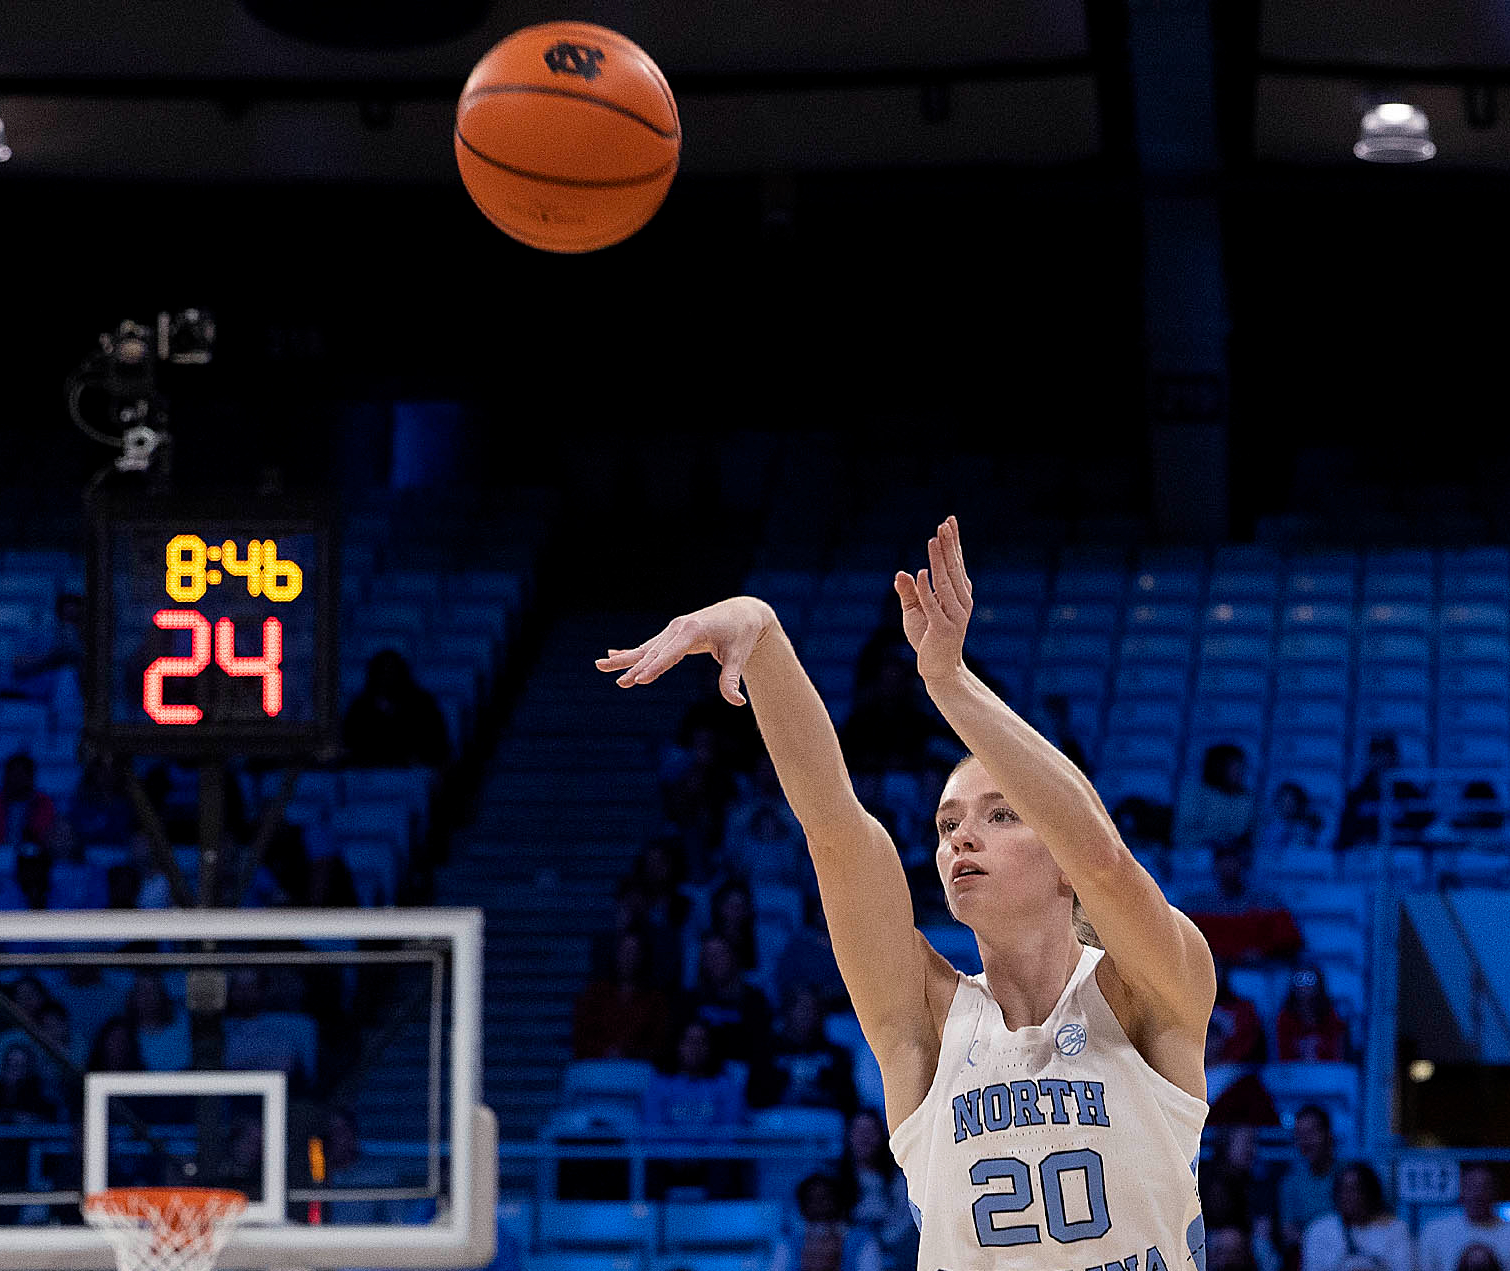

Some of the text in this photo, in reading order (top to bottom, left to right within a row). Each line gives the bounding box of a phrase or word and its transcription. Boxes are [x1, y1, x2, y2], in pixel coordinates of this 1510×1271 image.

[166, 535, 302, 602] 8:46
[143, 609, 282, 724] 24
[952, 1079, 1110, 1144] NORTH
[969, 1148, 1112, 1247] 20
